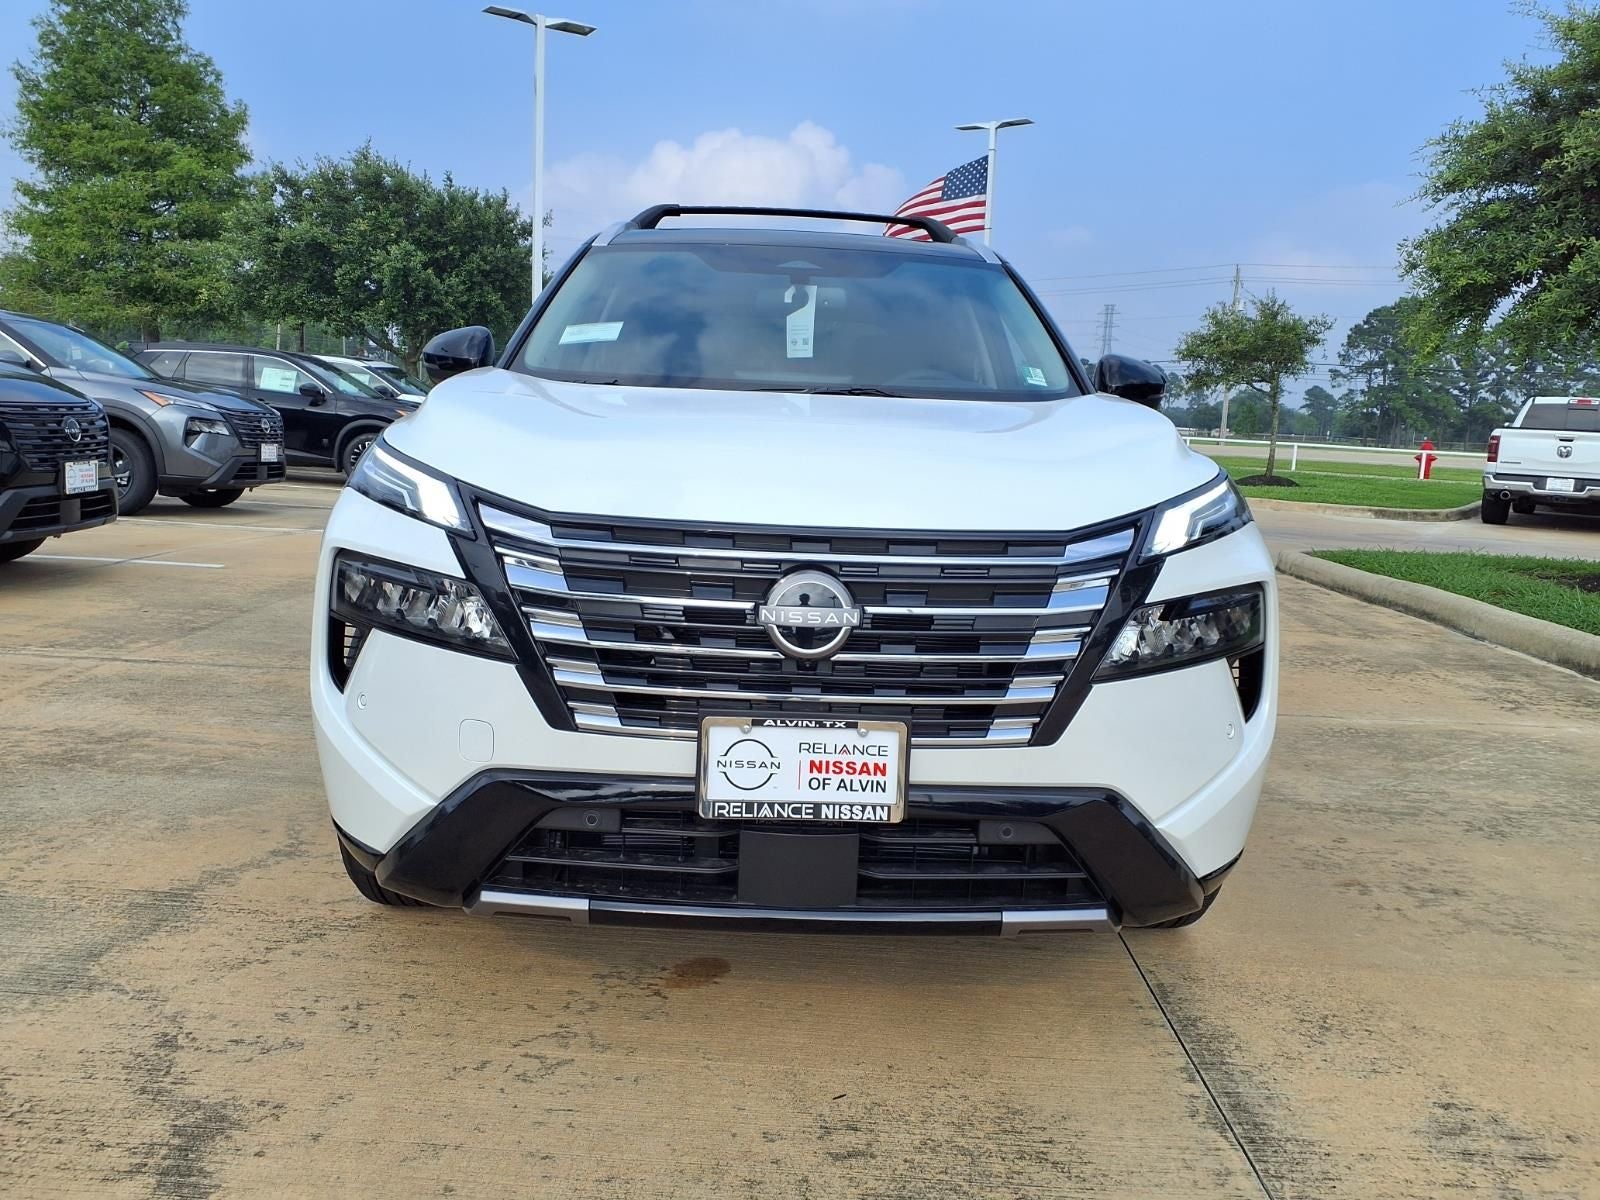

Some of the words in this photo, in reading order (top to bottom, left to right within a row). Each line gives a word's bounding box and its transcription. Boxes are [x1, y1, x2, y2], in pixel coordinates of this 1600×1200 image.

[761, 608, 858, 624] NISSAN
[823, 720, 846, 728] TX
[799, 742, 888, 757] RELIANCE
[716, 760, 780, 770] NISSAN
[809, 760, 887, 777] NISSAN
[808, 777, 831, 791] OF
[836, 778, 886, 793] ALVIN
[714, 802, 814, 819] RELIANCE
[821, 804, 888, 821] NISSAN
